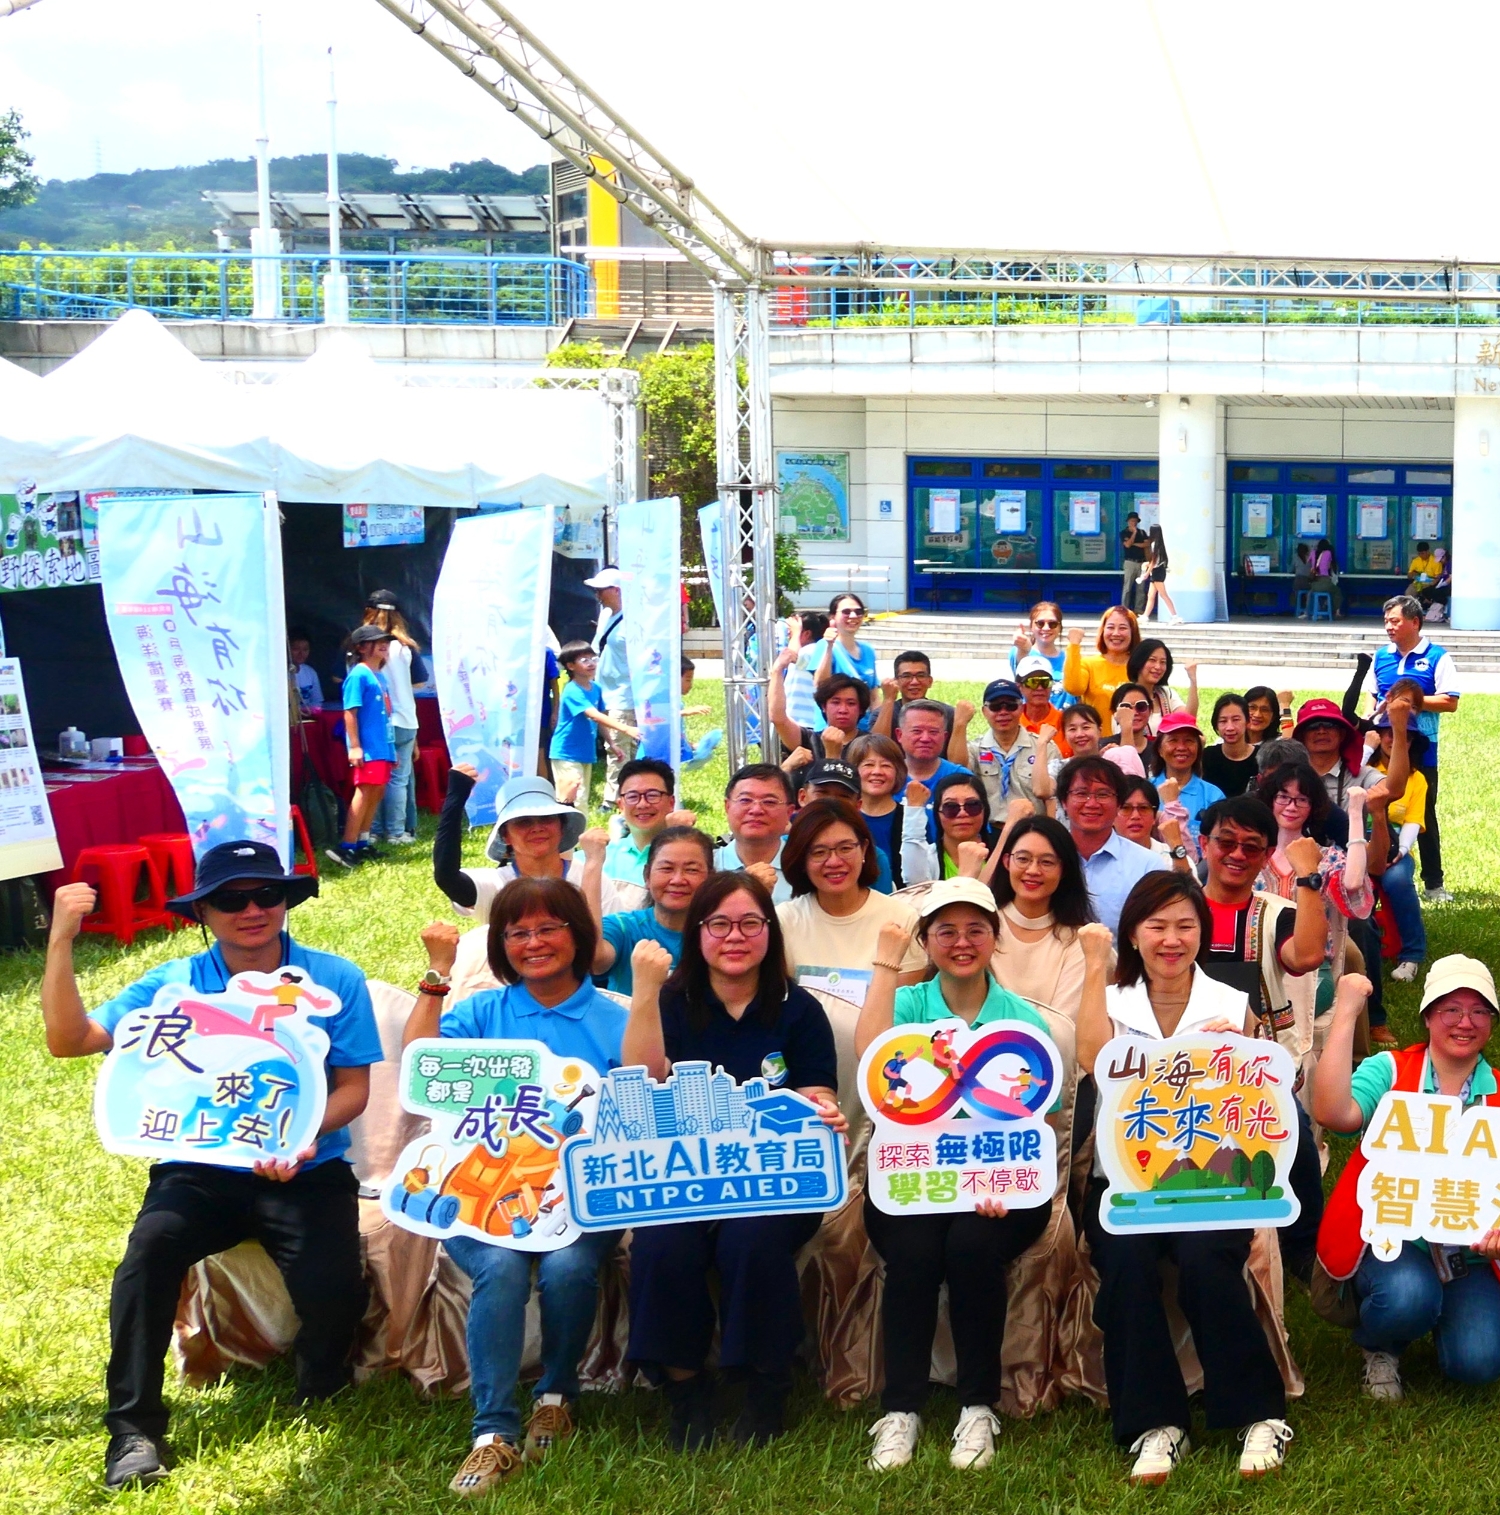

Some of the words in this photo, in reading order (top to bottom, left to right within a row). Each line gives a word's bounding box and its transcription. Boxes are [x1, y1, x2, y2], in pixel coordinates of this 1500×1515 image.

[121, 1005, 204, 1074] 浪
[214, 1072, 297, 1109] 來了
[416, 1053, 535, 1080] 每一次出發
[425, 1078, 474, 1105] 都是
[1106, 1045, 1281, 1097] 山海有你
[139, 1107, 292, 1150] 迎上去!
[453, 1083, 559, 1157] 成長
[1123, 1093, 1290, 1151] 未來有光
[1372, 1098, 1450, 1156] AI
[582, 1135, 826, 1188] 新北AI教育局
[614, 1183, 705, 1211] NTPC
[720, 1175, 799, 1200] AIED
